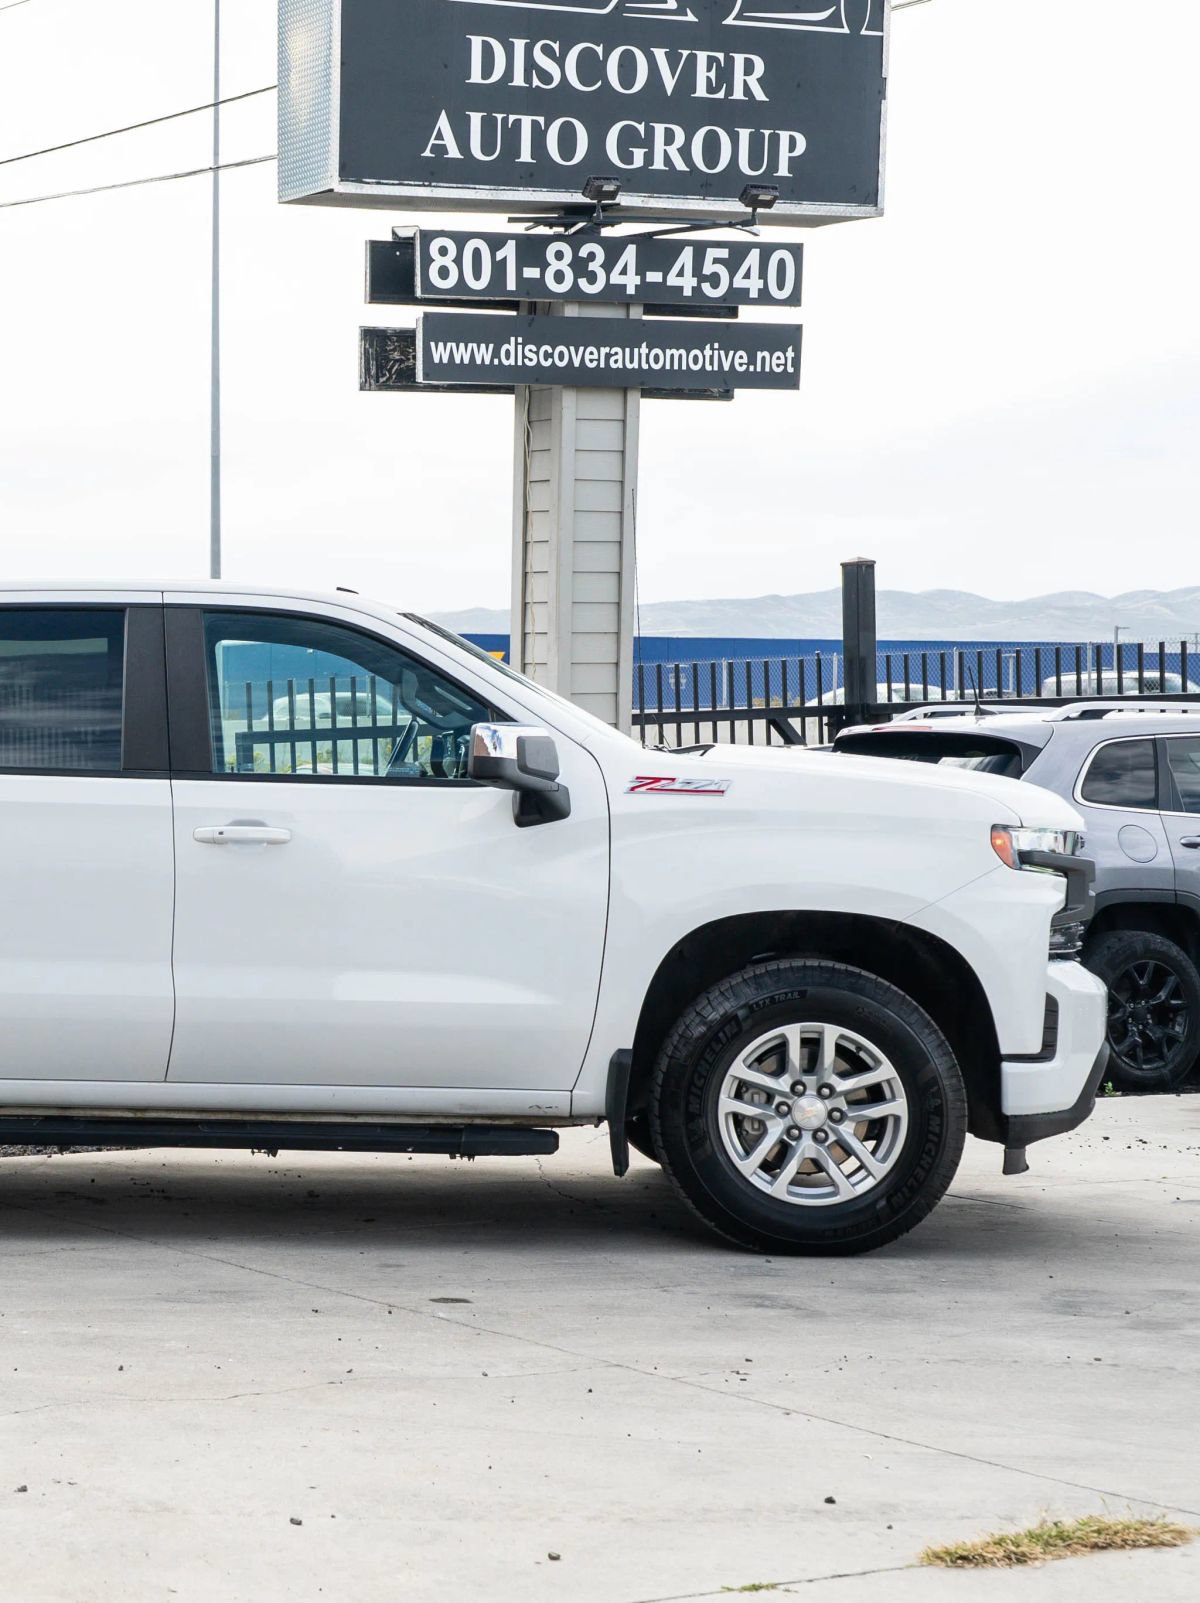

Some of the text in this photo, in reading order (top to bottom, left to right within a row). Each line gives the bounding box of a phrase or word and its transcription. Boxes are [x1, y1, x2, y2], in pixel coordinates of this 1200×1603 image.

[465, 35, 769, 102] DISCOVER
[421, 110, 807, 177] AUTO GROUP
[428, 236, 796, 300] 801-834-4540
[429, 336, 795, 373] www.discoverautomotive.net
[625, 776, 731, 796] Z71
[753, 991, 801, 1011] LTX TRAIL
[688, 1020, 741, 1113] MICHELIN
[892, 1115, 942, 1207] MICHELIN
